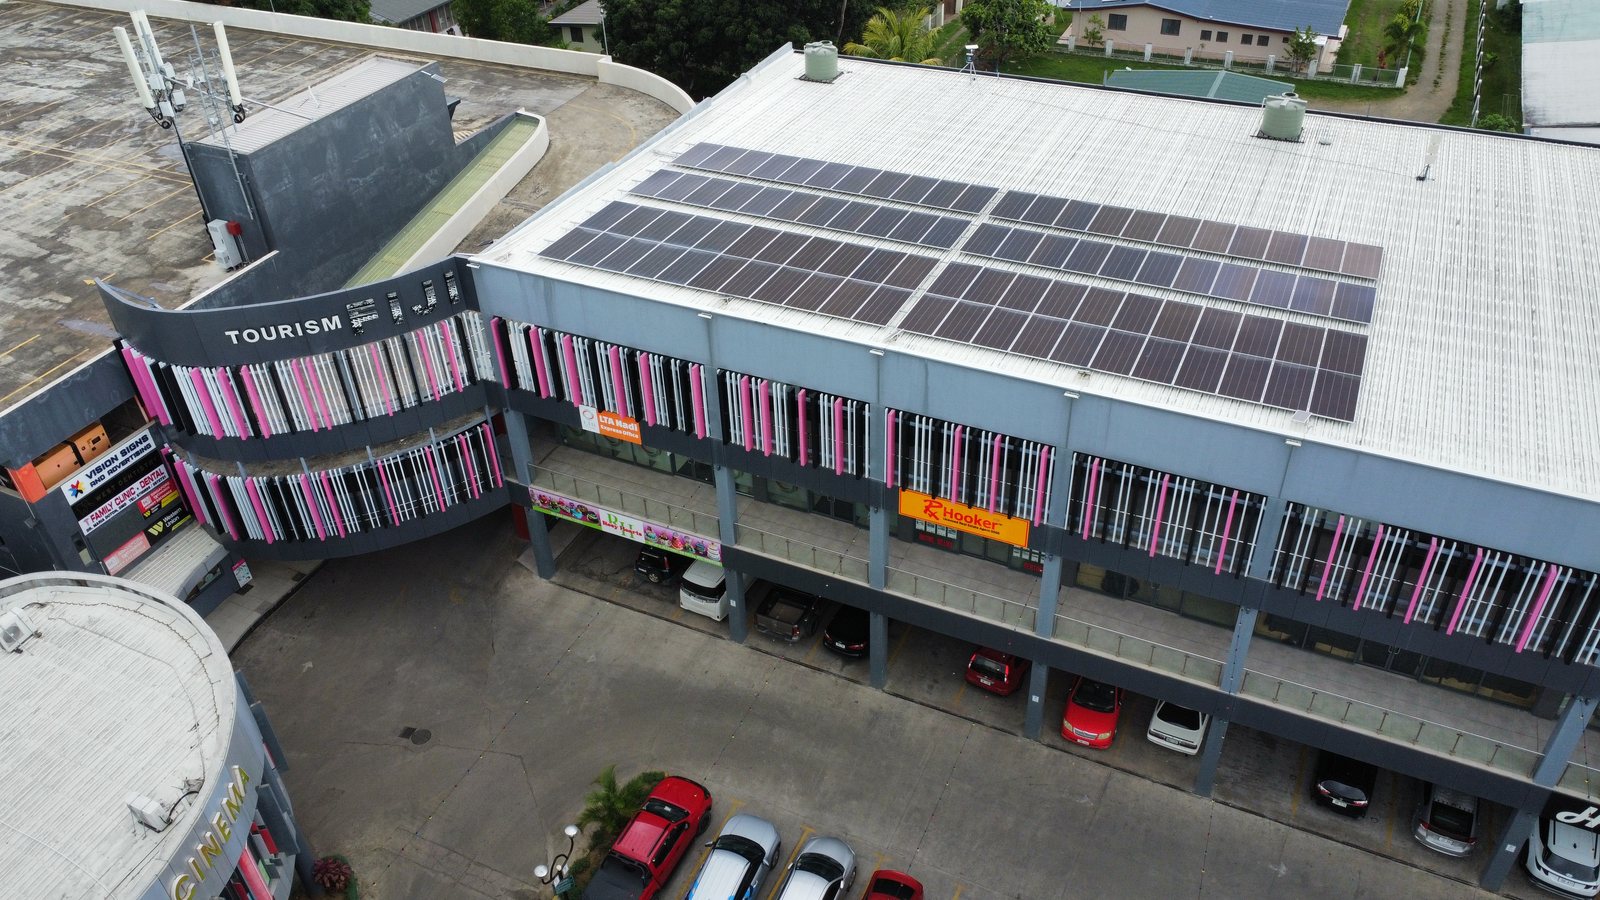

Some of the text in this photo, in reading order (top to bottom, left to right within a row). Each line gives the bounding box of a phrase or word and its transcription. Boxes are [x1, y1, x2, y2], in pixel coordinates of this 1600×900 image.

[224, 271, 460, 345] TOURISM FIJI
[599, 415, 615, 426] LTA
[615, 419, 638, 431] Nadi
[622, 430, 639, 439] Office
[85, 434, 149, 479] VISION SIGNS
[90, 443, 152, 487] AND ADVERTISING
[90, 502, 113, 522] FAMILY
[114, 487, 136, 506] CLINIC
[139, 468, 165, 489] DENTAL
[162, 507, 182, 523] Western
[165, 515, 180, 528] Union
[943, 507, 999, 530] Hooker
[170, 764, 250, 900] CINEMA
